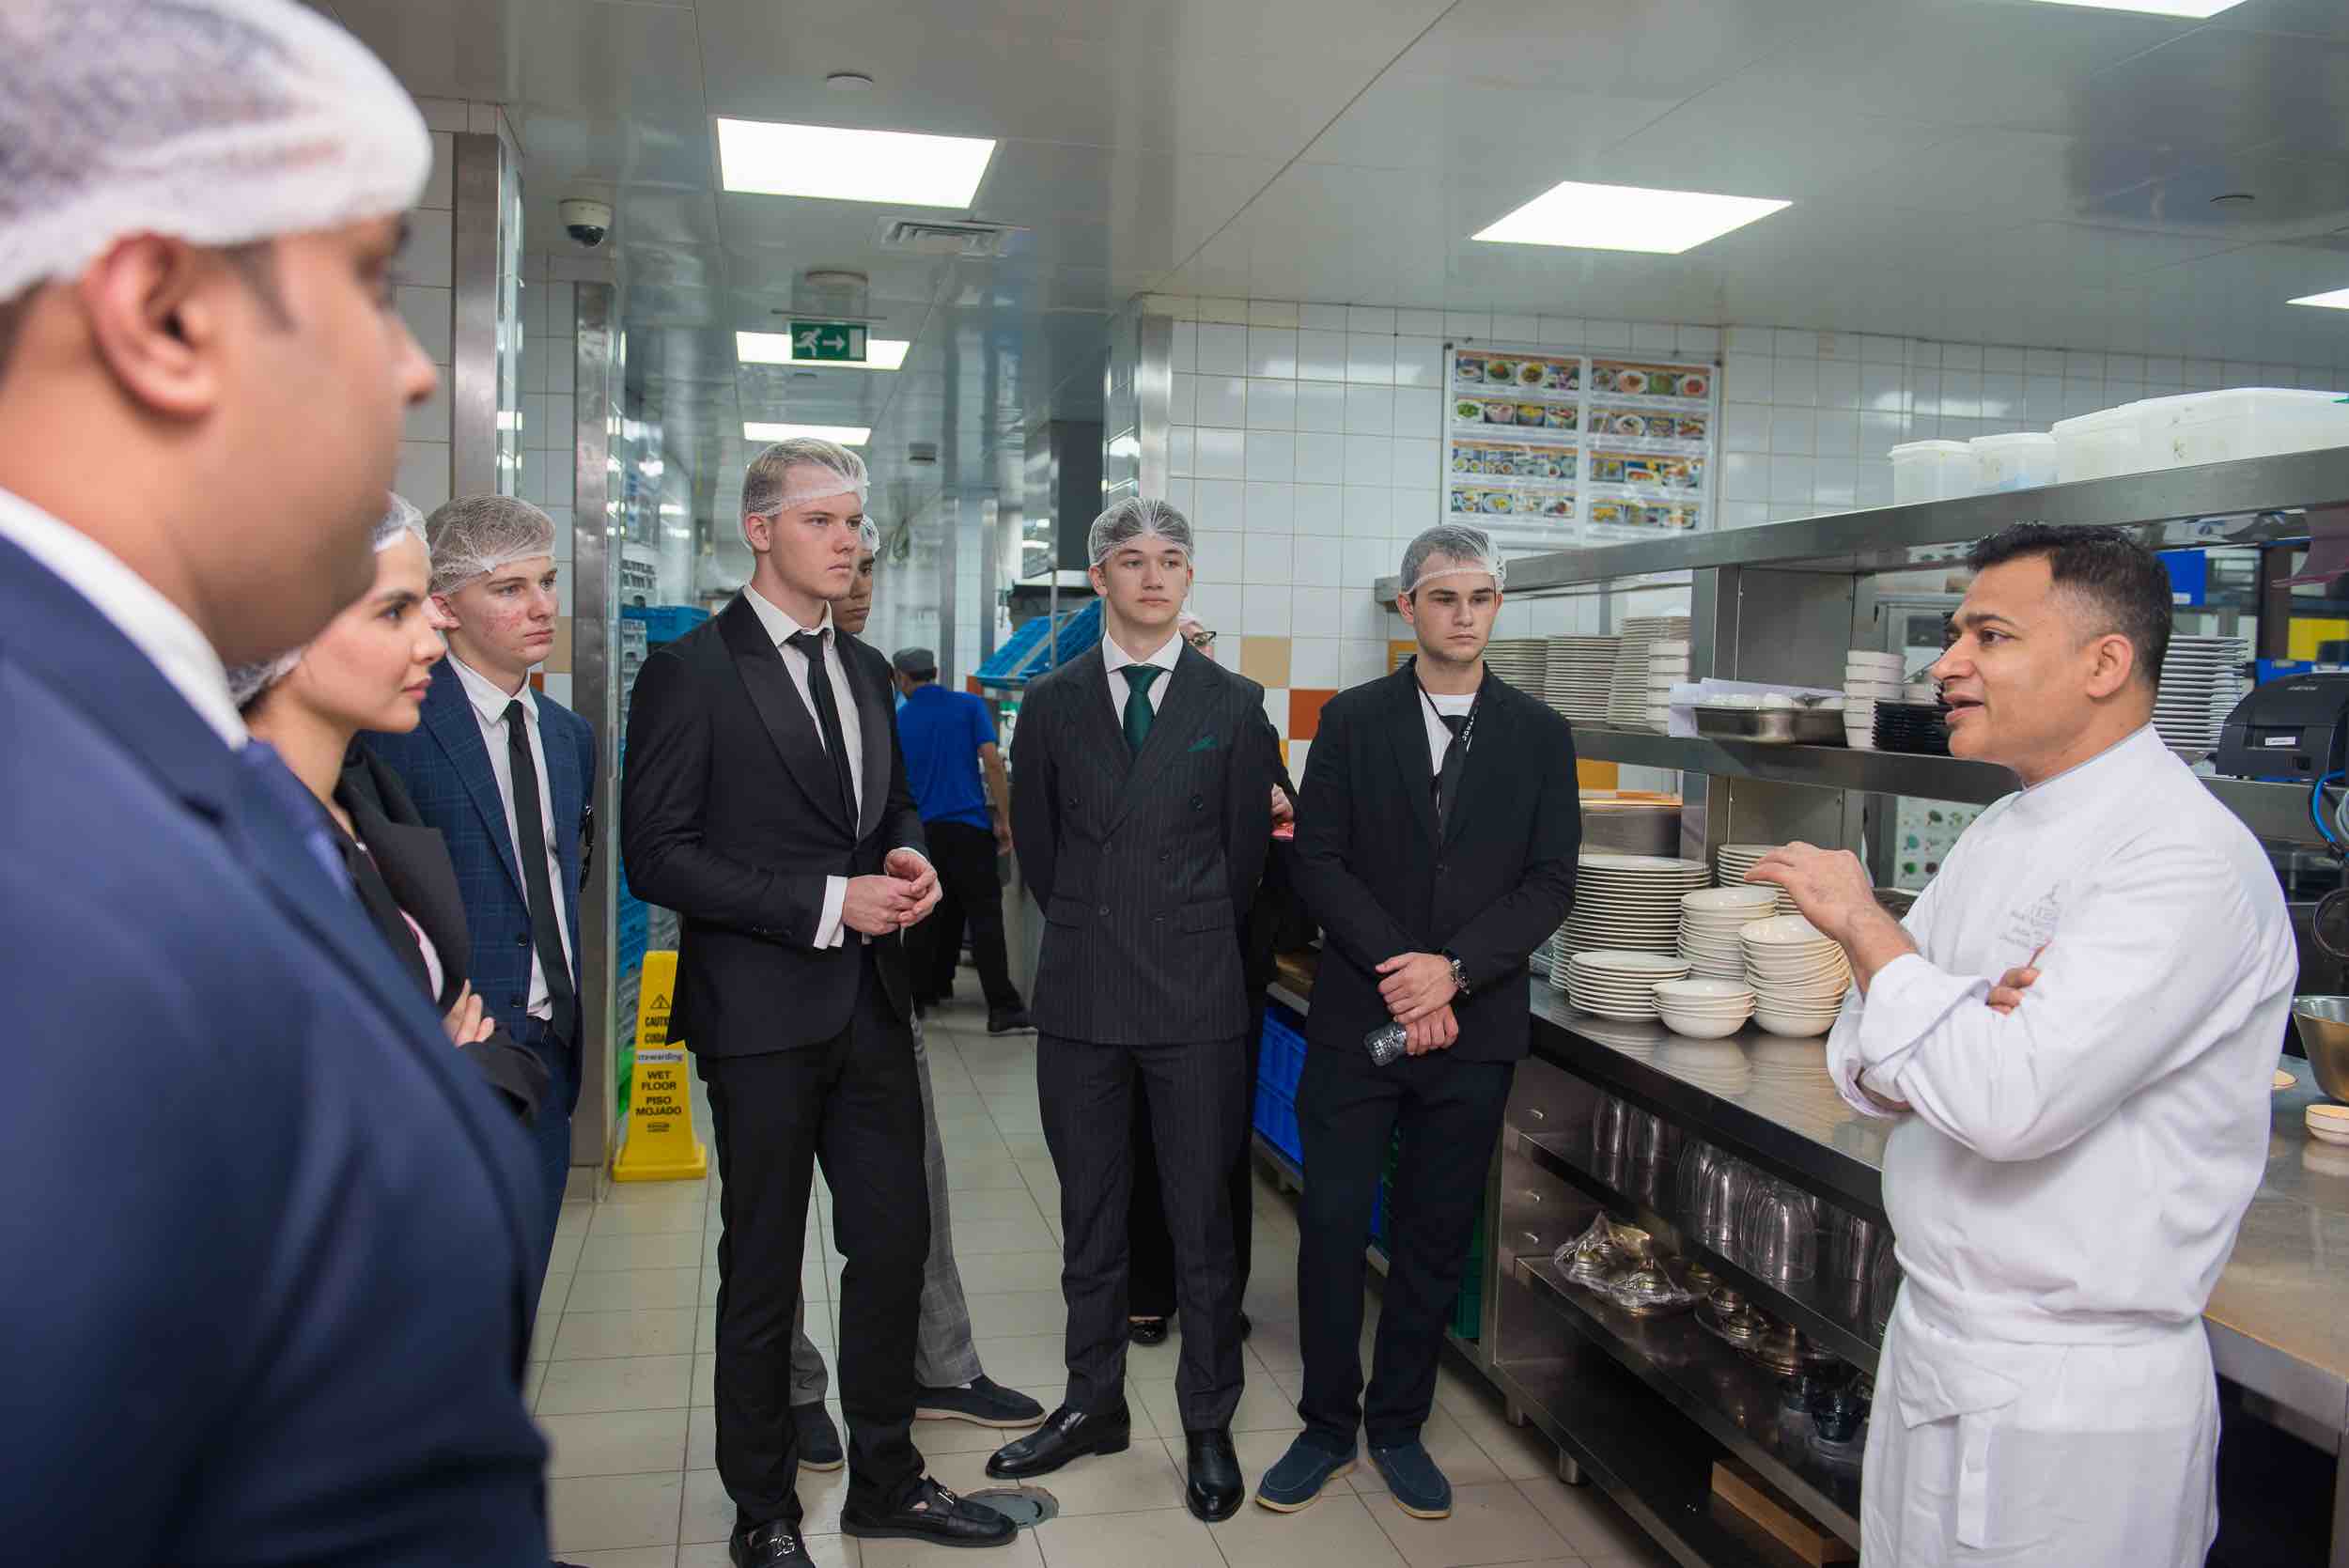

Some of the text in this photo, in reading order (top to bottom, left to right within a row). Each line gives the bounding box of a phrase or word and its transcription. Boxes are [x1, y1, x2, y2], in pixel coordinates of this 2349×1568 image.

[646, 1070, 671, 1079] WET
[641, 1081, 677, 1090] FLOOR
[646, 1096, 671, 1105] PISO
[635, 1107, 682, 1116] MOJADO
